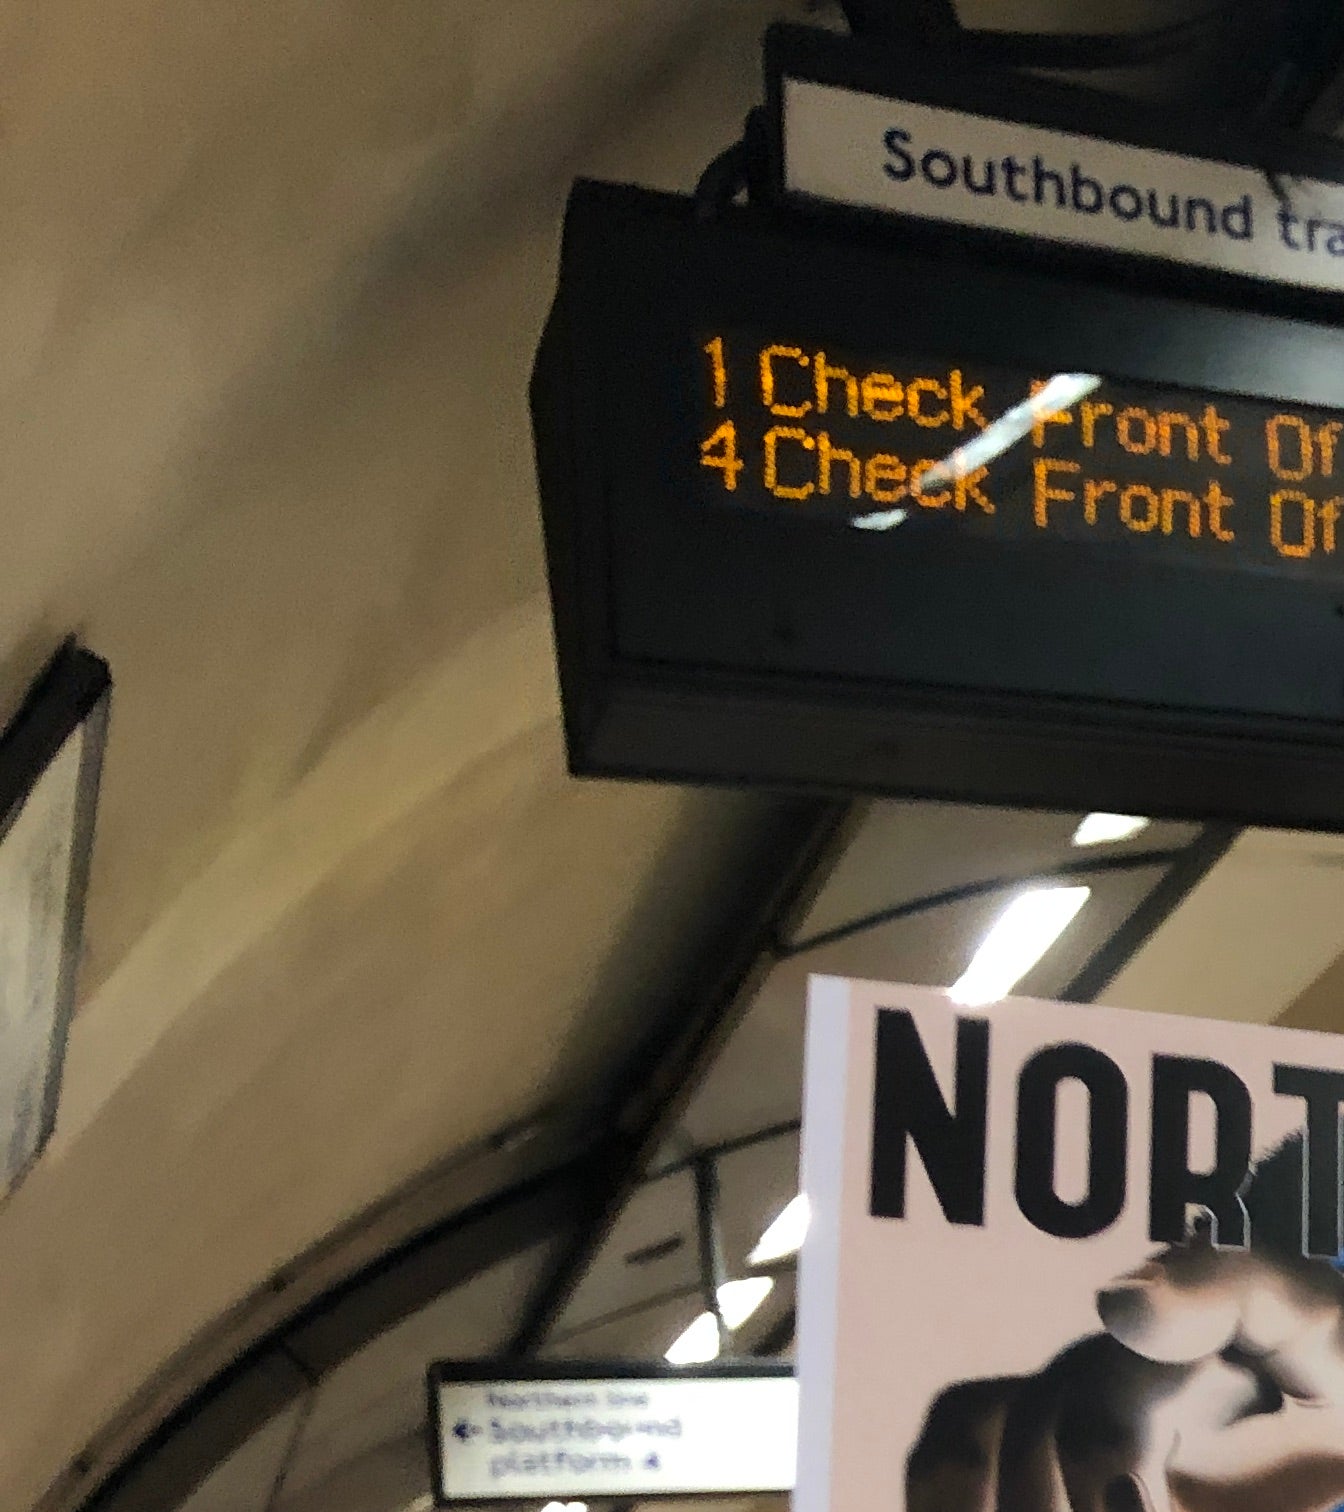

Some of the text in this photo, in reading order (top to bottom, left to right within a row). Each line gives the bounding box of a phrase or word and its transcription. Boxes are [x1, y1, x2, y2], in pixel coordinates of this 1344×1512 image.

[882, 126, 1255, 242] Southbound
[704, 336, 728, 408] 1
[758, 344, 988, 431] Check
[1031, 377, 1233, 466] Front
[1264, 413, 1344, 482] Of
[700, 420, 744, 492] 4
[763, 425, 997, 516] Check
[1032, 456, 1236, 543] Front
